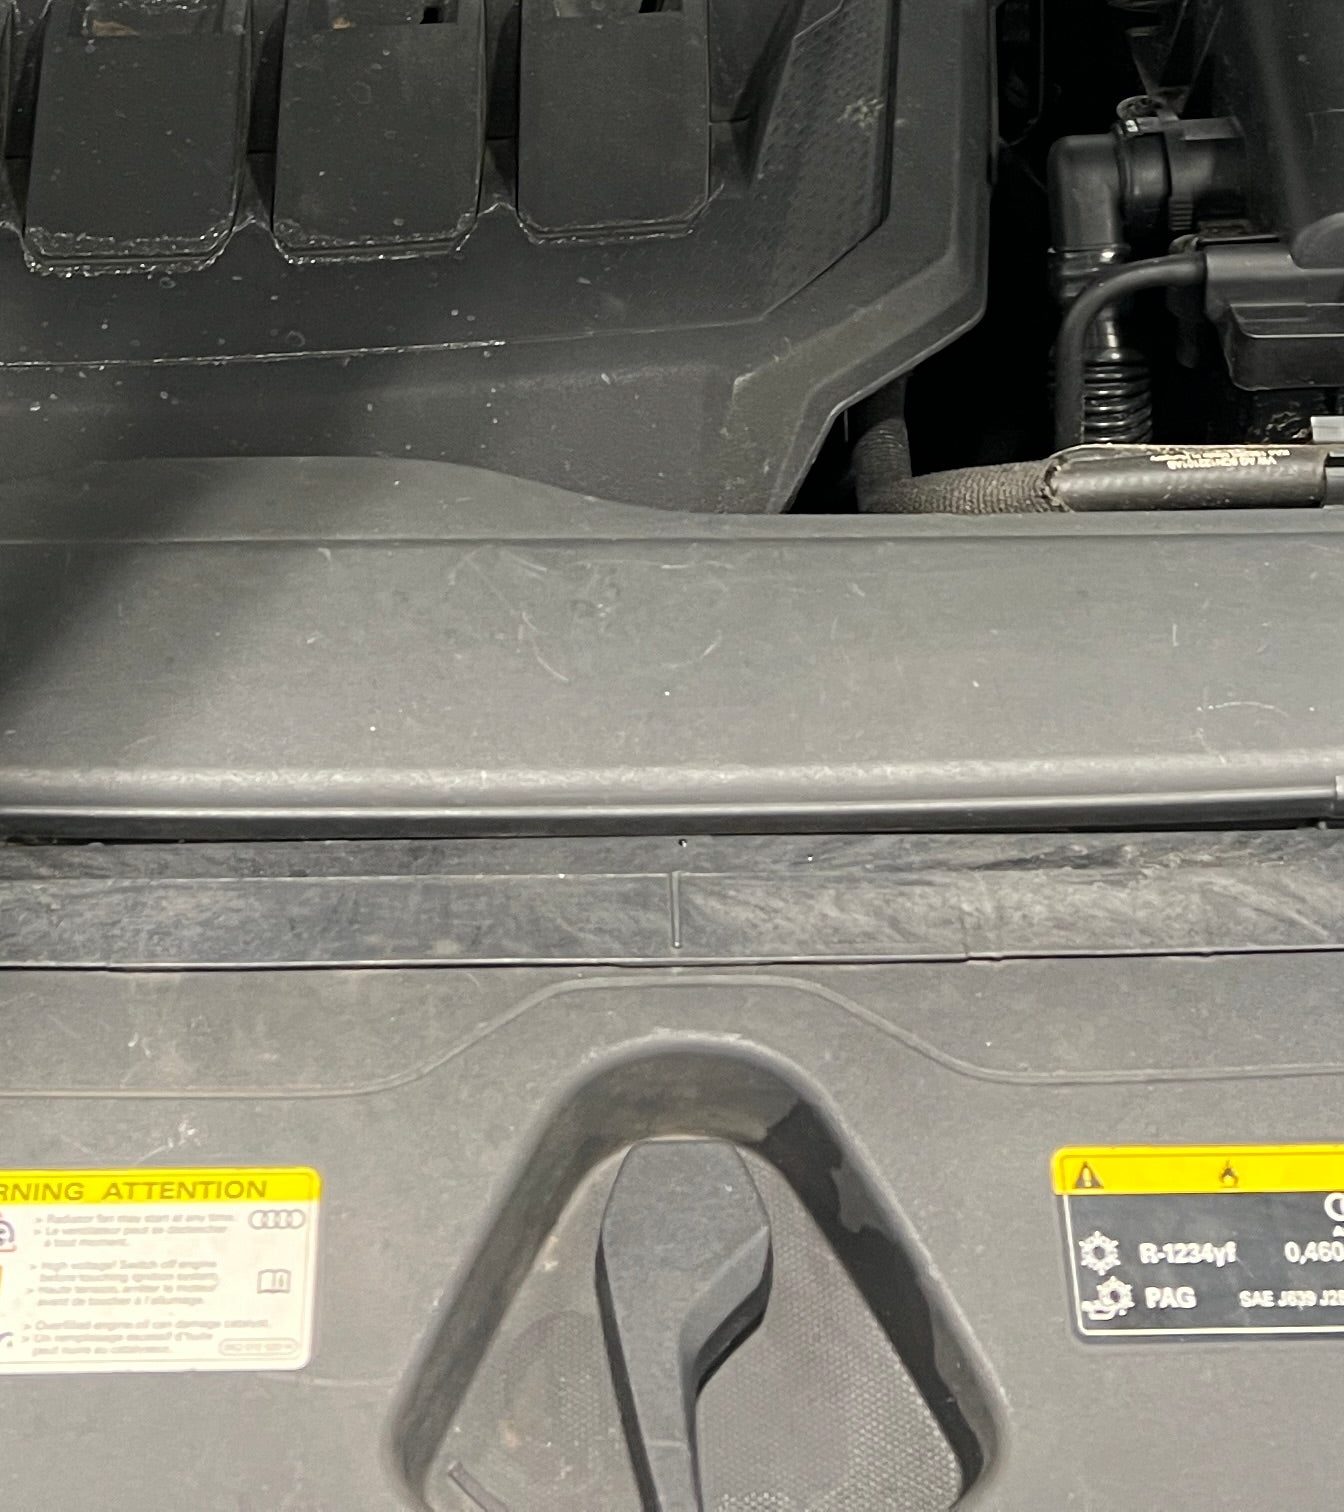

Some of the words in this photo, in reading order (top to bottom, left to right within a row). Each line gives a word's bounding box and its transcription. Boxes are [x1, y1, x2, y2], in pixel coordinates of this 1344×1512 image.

[101, 1179, 268, 1200] ATTENTION
[1139, 1241, 1237, 1267] R-1234yf
[1145, 1286, 1197, 1308] PAG
[1239, 1291, 1274, 1307] SAE
